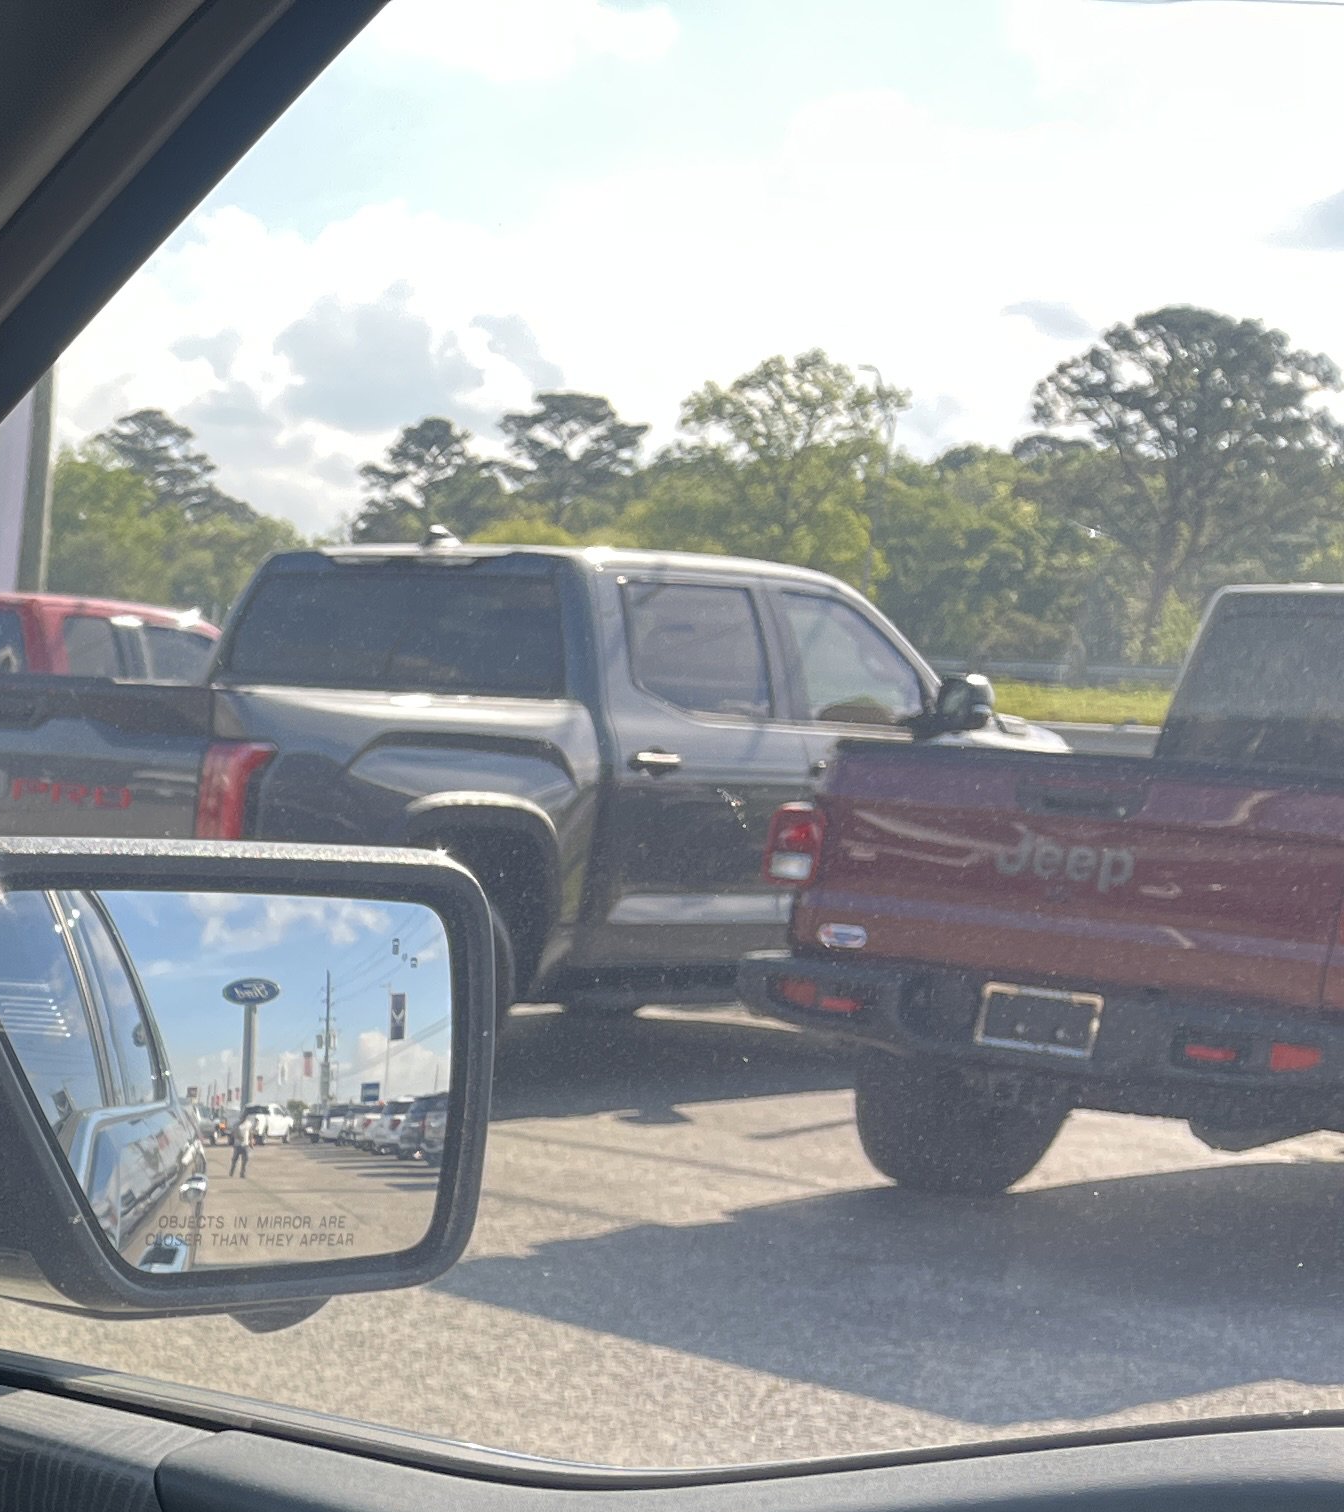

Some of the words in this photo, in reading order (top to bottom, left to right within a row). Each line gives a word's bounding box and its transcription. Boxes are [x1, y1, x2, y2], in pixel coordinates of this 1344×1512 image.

[12, 777, 133, 810] PRO
[995, 831, 1135, 893] Jeep
[159, 1215, 225, 1229] OBJECTS
[234, 1215, 248, 1229] IN
[256, 1215, 311, 1229] MIRROR
[319, 1215, 347, 1229] ARE
[145, 1233, 202, 1247] CLOSER
[211, 1233, 249, 1247] THAN
[258, 1233, 294, 1247] THEY
[299, 1232, 355, 1246] APPEAR
